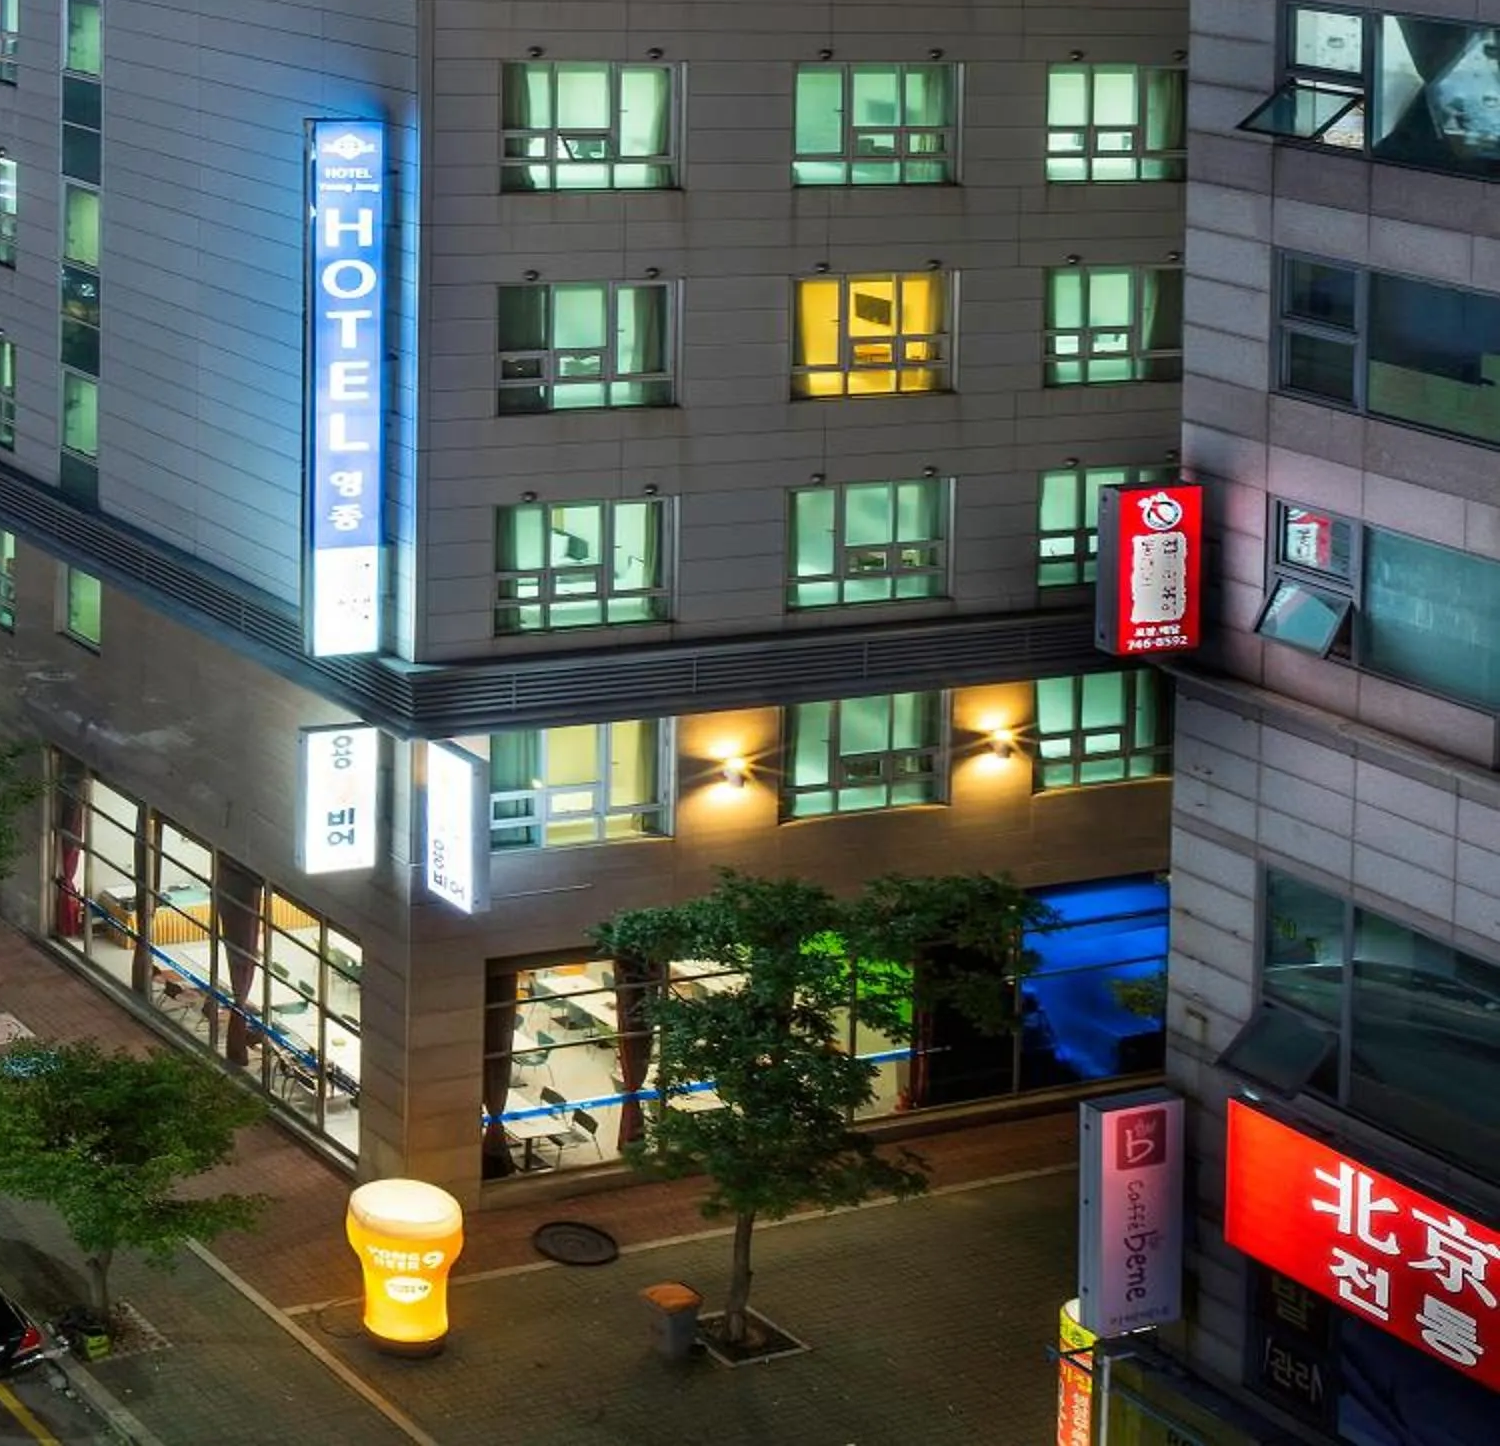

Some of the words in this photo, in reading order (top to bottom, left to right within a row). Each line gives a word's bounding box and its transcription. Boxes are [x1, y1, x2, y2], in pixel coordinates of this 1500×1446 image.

[325, 166, 373, 179] HOTEL
[322, 208, 377, 452] HOTEL
[1311, 1161, 1500, 1309] 北京
[1328, 1247, 1485, 1367] 전통
